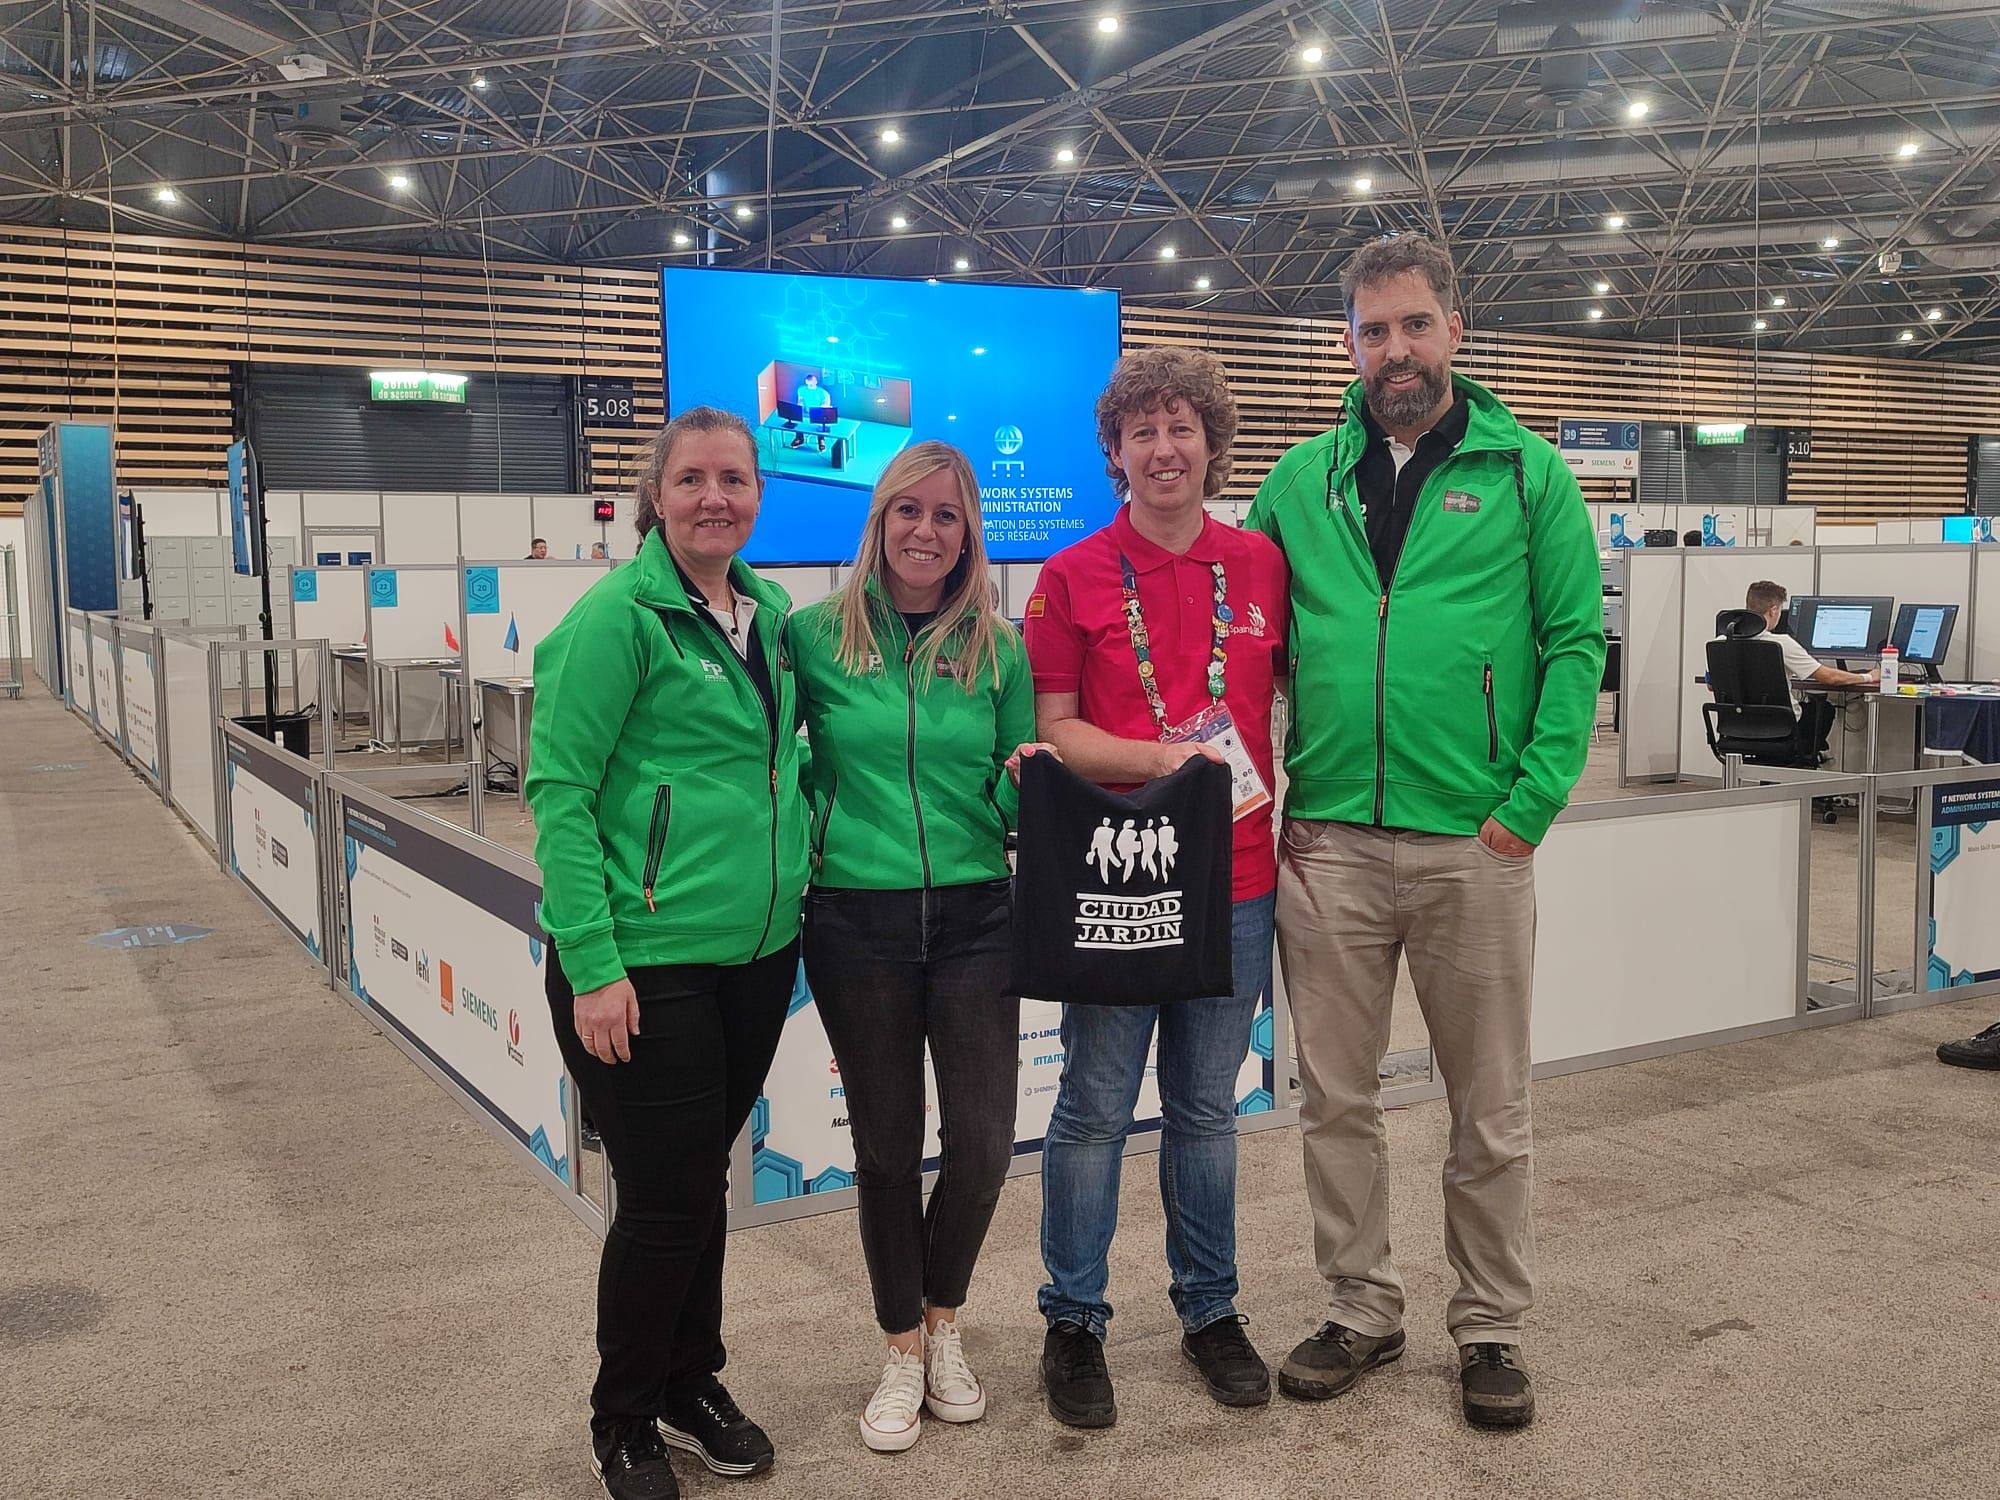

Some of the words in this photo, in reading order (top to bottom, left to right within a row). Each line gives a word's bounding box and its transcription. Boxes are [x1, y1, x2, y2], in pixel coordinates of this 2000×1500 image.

[587, 398, 630, 417] 5.08
[1563, 428, 1577, 441] 39
[1788, 442, 1810, 455] 5.10
[980, 487, 1017, 499] WORK
[1020, 487, 1073, 499] SYSTEMS
[980, 501, 1061, 513] MINISTRATION
[982, 519, 1016, 530] RATION
[1018, 519, 1036, 529] DES
[1039, 517, 1085, 529] SYSTÈMES
[987, 531, 1005, 541] DES
[1007, 529, 1050, 541] RÉSEAUX
[478, 584, 488, 592] 20
[1941, 795, 1947, 804] IT
[1948, 793, 1977, 803] NETWORK
[1941, 802, 1990, 815] ADMINISTRATION
[1079, 899, 1182, 920] CIUDAD
[1077, 922, 1182, 943] JARDIN
[461, 986, 498, 1031] SIEMENS
[830, 1058, 840, 1074] 3
[830, 1087, 846, 1099] FE
[831, 1117, 849, 1129] Mas
